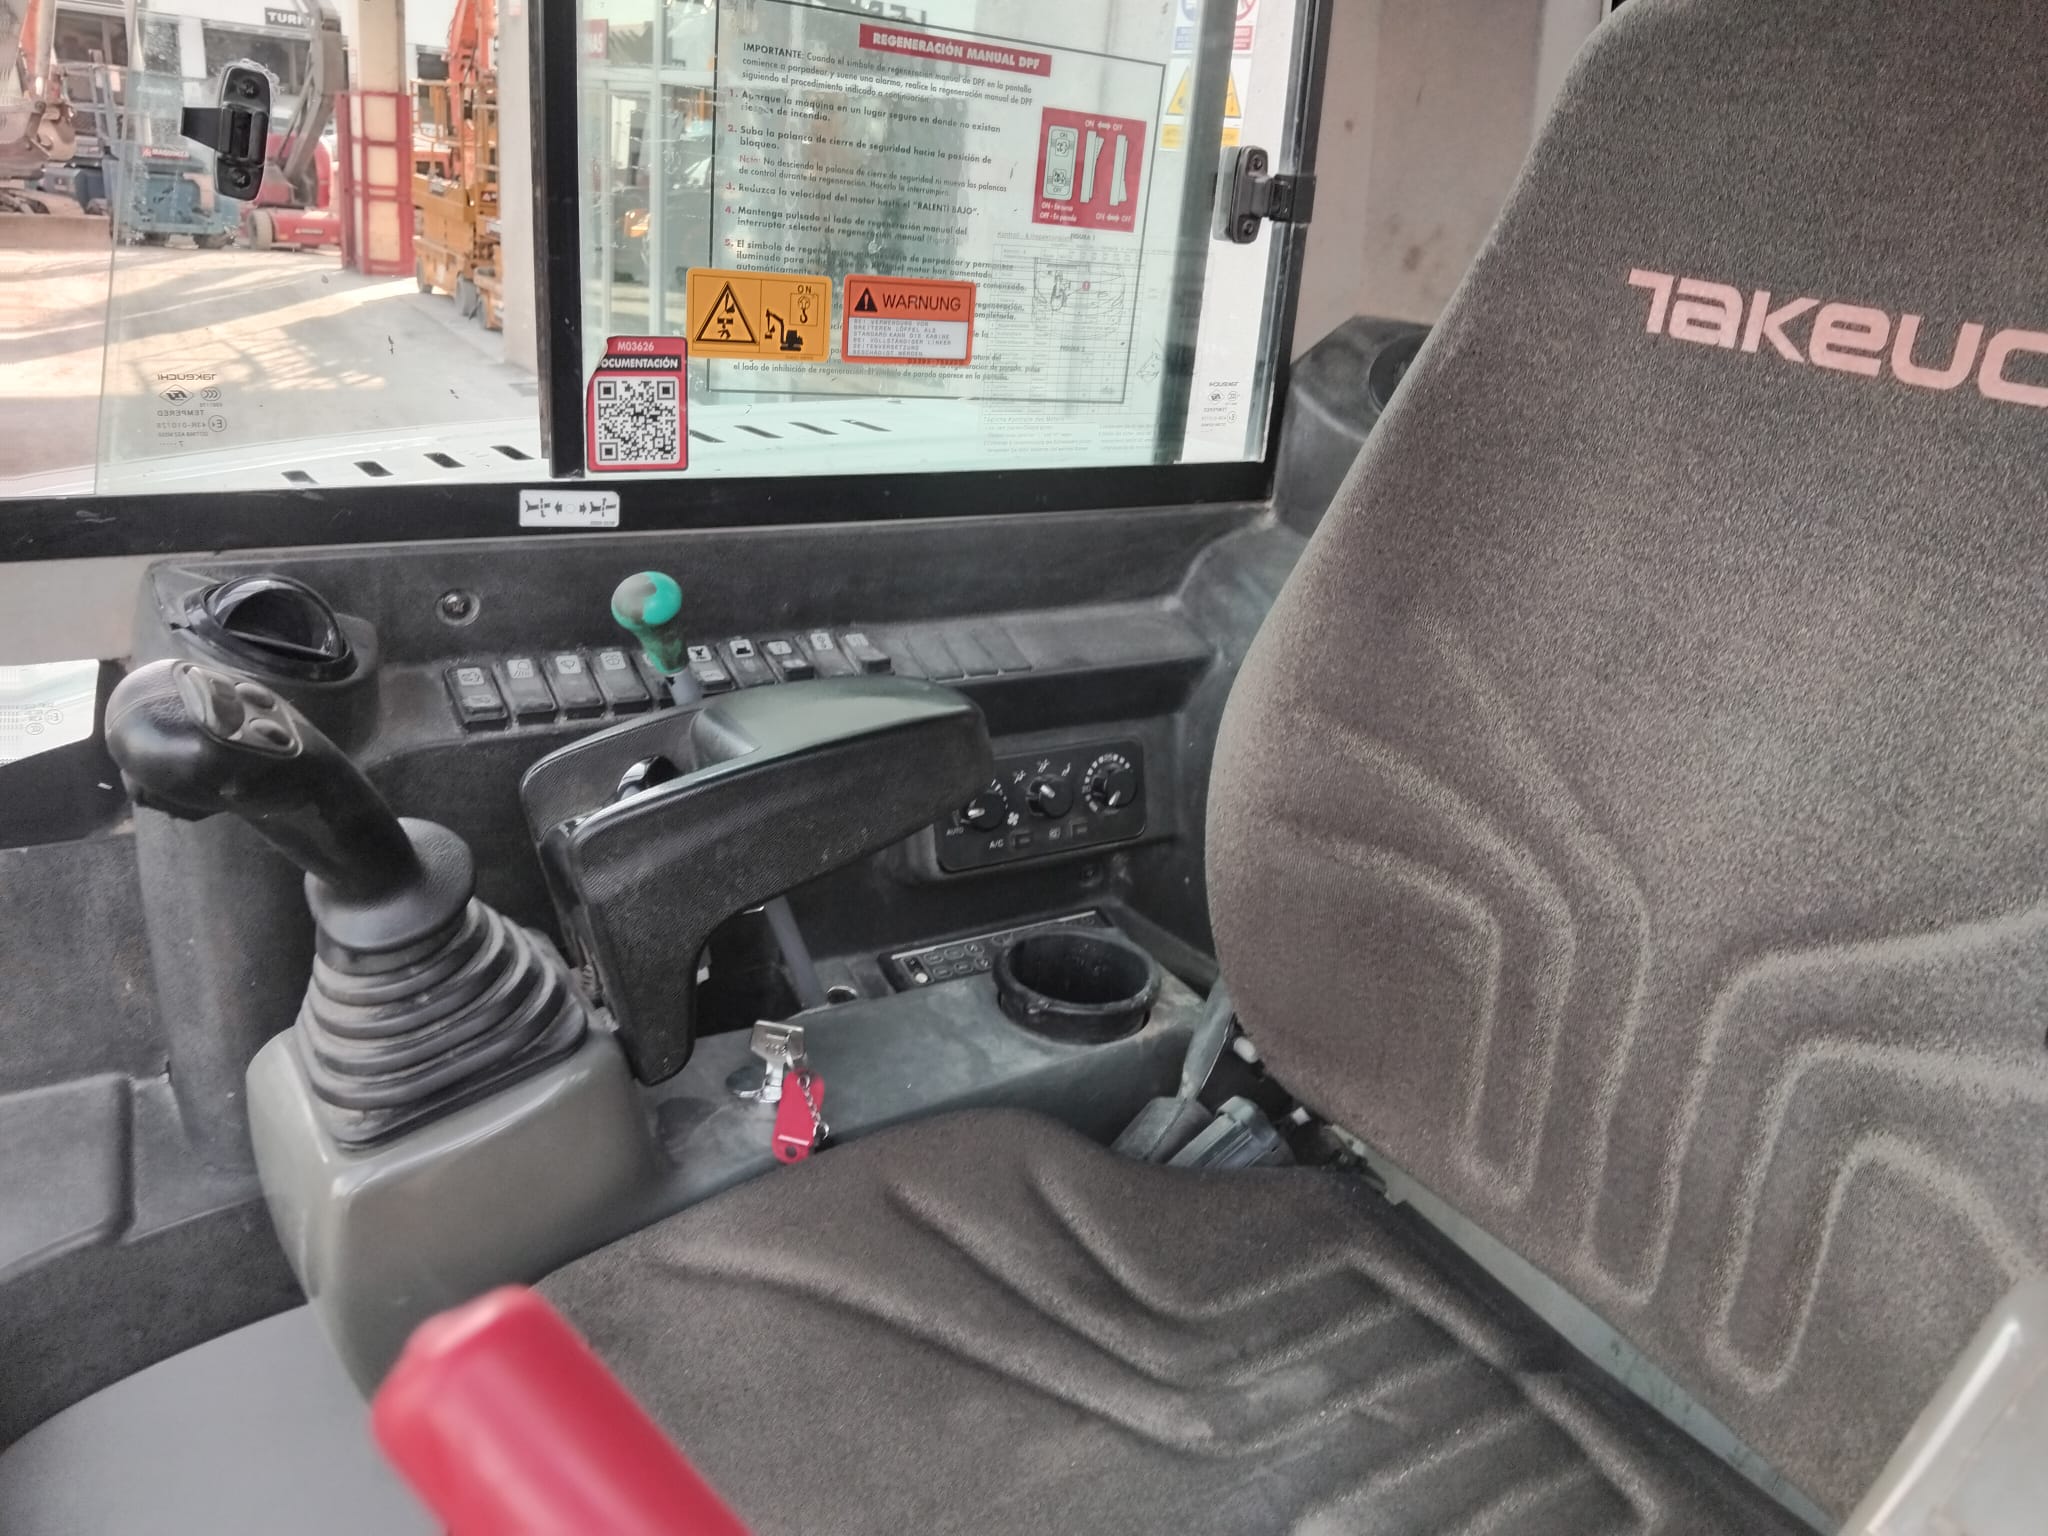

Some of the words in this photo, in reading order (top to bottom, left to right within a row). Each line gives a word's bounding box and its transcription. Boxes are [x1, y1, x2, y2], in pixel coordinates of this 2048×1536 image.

[873, 32, 963, 57] REGENERACIÓN
[966, 47, 1015, 66] MANUAL
[1018, 57, 1040, 70] DPF
[743, 43, 804, 59] IMPORTANTE:
[807, 52, 836, 64] Cuando
[837, 56, 845, 64] el
[876, 62, 886, 71] de
[935, 73, 961, 83] manual
[962, 74, 971, 84] de
[973, 77, 986, 87] DPF
[997, 80, 1005, 90] la
[1005, 83, 1032, 94] pantalla
[742, 58, 778, 69] comience
[788, 65, 827, 77] parpadear
[829, 71, 834, 79] y
[837, 71, 857, 79] suene
[860, 75, 874, 83] una
[875, 75, 903, 87] alarma,
[905, 80, 929, 91] realice
[930, 82, 937, 92] la
[939, 86, 983, 99] regeneración
[984, 93, 1009, 103] manual
[1010, 95, 1019, 104] de
[1020, 97, 1033, 106] DPF
[742, 71, 779, 83] siguiendo
[781, 75, 789, 83] el
[790, 77, 843, 91] procedimiento
[845, 84, 876, 97] indicado
[730, 89, 738, 98] 1.
[784, 96, 792, 105] la
[795, 97, 834, 111] máquina
[837, 103, 848, 112] en
[850, 106, 861, 114] un
[863, 106, 886, 118] lugar
[889, 113, 917, 122] seguro
[932, 116, 957, 127] donde
[960, 121, 970, 129] no
[972, 122, 1001, 133] existan
[777, 105, 788, 115] de
[790, 108, 831, 122] incendio.
[727, 124, 737, 133] 2.
[740, 125, 763, 136] Suba
[766, 128, 775, 138] la
[778, 131, 813, 142] palanca
[816, 134, 827, 144] de
[829, 137, 854, 147] cierre
[856, 139, 867, 149] de
[869, 142, 911, 154] seguridad
[913, 146, 935, 157] hacia
[937, 149, 946, 158] la
[948, 152, 980, 163] posición
[982, 156, 992, 164] de
[740, 137, 780, 150] bloqueo.
[738, 166, 749, 175] de
[750, 167, 777, 178] control
[778, 170, 807, 181] durante
[809, 173, 817, 182] la
[870, 181, 897, 191] Hacerlo
[898, 184, 905, 192] la
[763, 157, 776, 166] No
[777, 158, 814, 170] descienda
[816, 162, 824, 171] la
[825, 163, 854, 175] palanca
[856, 167, 865, 175] de
[867, 169, 887, 179] cierre
[889, 171, 898, 180] de
[900, 172, 934, 184] seguridad
[936, 176, 942, 184] ni
[943, 179, 966, 188] mueva
[967, 179, 977, 190] las
[978, 182, 1007, 193] palancas
[738, 183, 776, 195] Reduzca
[778, 185, 787, 195] la
[790, 187, 832, 200] velocidad
[834, 191, 848, 201] del
[850, 195, 875, 205] motor
[725, 206, 735, 214] 4.
[737, 206, 783, 220] Mantenga
[785, 210, 821, 222] pulsado
[823, 214, 831, 222] el
[833, 214, 852, 225] lado
[855, 216, 865, 225] de
[923, 225, 953, 235] manual
[955, 227, 967, 236] del
[737, 218, 786, 230] interruptor
[788, 221, 822, 232] selector
[824, 223, 835, 234] de
[1070, 232, 1092, 241] FIGURA
[736, 239, 744, 248] El
[747, 240, 782, 251] símbolo
[785, 242, 796, 251] de
[910, 253, 920, 263] de
[922, 255, 963, 267] parpadear
[736, 251, 781, 262] iluminado
[783, 255, 804, 265] para
[906, 265, 930, 274] motor
[797, 285, 812, 294] ON
[882, 293, 961, 312] WARNUNG
[617, 341, 655, 352] M03626
[601, 356, 679, 369] OCUMENTACIÓN
[742, 363, 759, 371] lado
[760, 363, 770, 372] de
[772, 364, 807, 373] inhibición
[808, 365, 817, 374] de
[903, 369, 911, 377] de
[913, 370, 937, 379] parada
[938, 371, 964, 380] aparece
[974, 372, 981, 380] la
[946, 826, 965, 836] AUTO
[989, 838, 1004, 850] A/C
